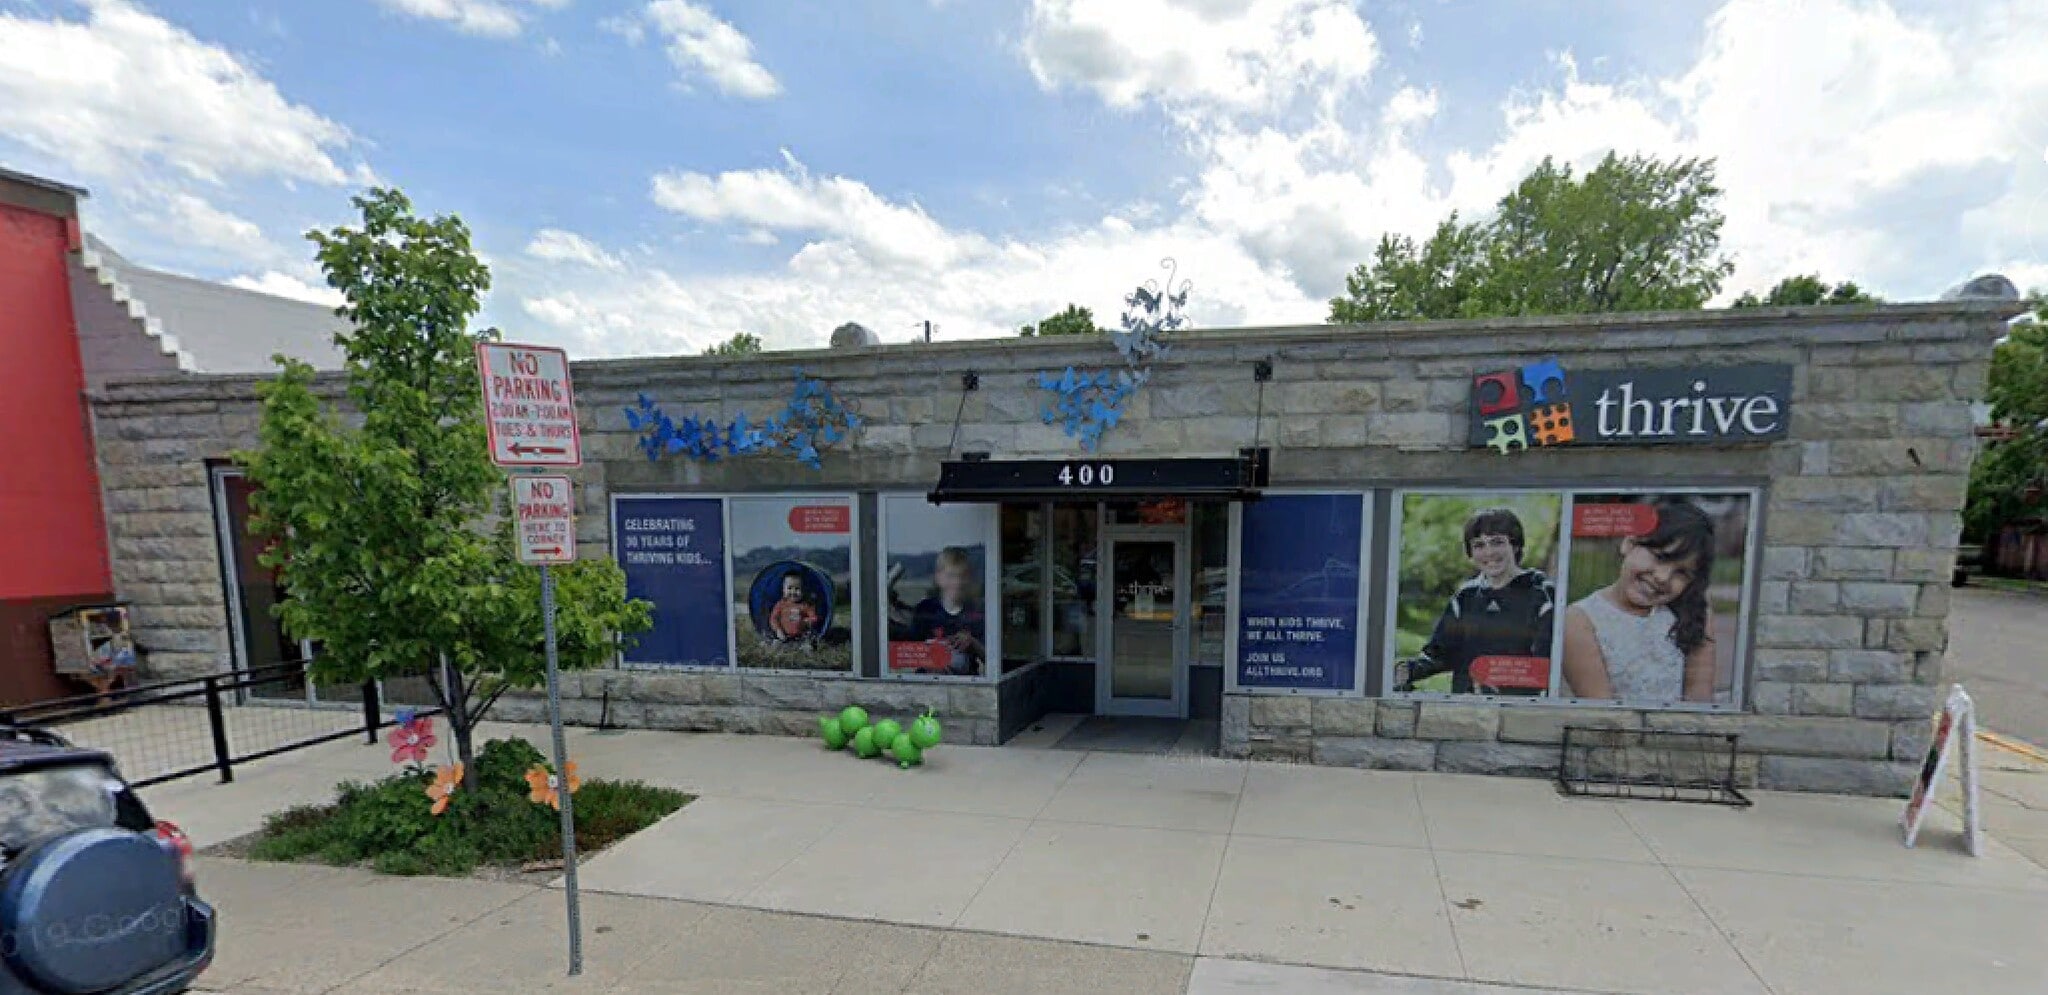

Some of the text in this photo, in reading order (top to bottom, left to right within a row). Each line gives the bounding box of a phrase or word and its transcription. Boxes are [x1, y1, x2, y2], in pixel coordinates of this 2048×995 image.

[510, 352, 539, 376] NO
[493, 376, 562, 403] PARKING
[1595, 380, 1779, 436] thrive
[526, 422, 537, 437] &
[1058, 464, 1114, 486] 400
[530, 481, 554, 499] NO
[519, 502, 569, 520] PARKING
[624, 518, 695, 531] CELEBRATING
[527, 534, 565, 545] CORNER
[641, 534, 674, 548] YEARS
[676, 535, 690, 547] OF
[626, 551, 674, 565] THRIVING
[1246, 616, 1276, 627] WHEN
[1278, 616, 1304, 628] KIDS
[1246, 630, 1262, 640] WE
[1264, 630, 1283, 640] ALL
[1246, 652, 1286, 663] JOIN US
[1246, 665, 1324, 678] ALLTHRIVE.ORG
